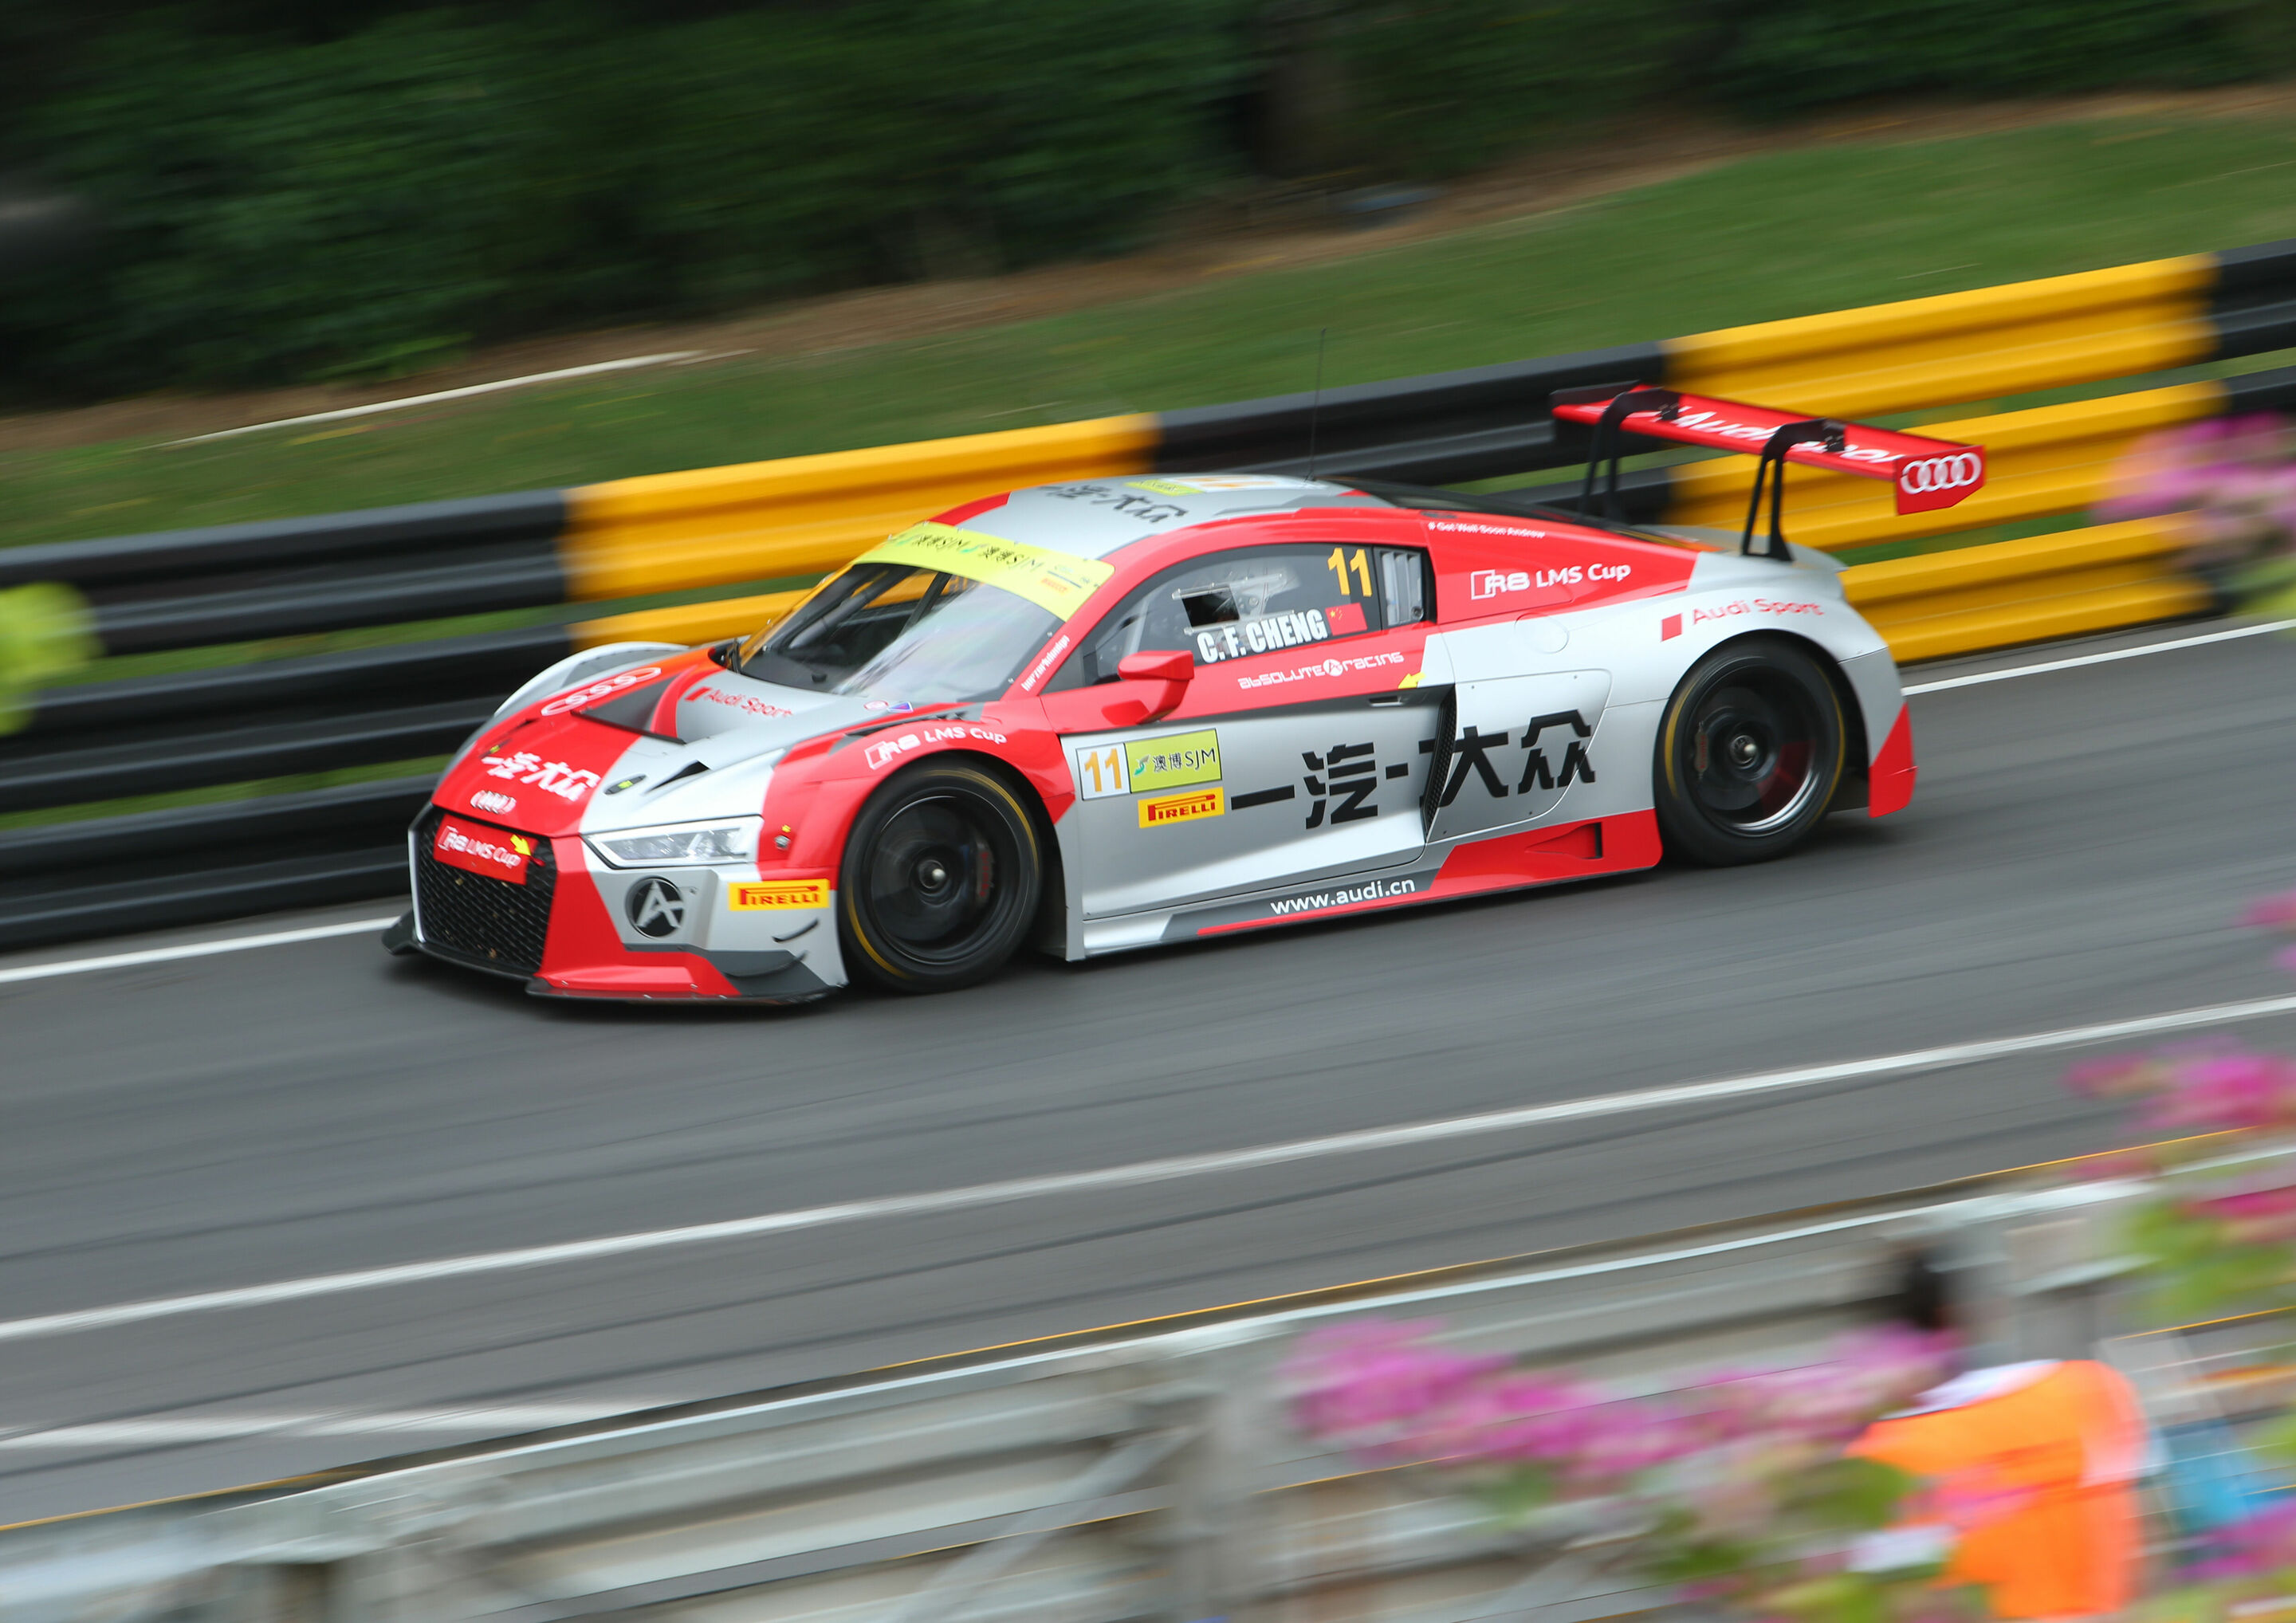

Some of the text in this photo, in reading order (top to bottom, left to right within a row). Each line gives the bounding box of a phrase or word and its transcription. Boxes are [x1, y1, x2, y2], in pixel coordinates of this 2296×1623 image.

[1327, 548, 1372, 597] 11
[1478, 564, 1631, 597] R8 LMS Cup
[1693, 598, 1825, 625] Audi Sport
[1197, 608, 1328, 664] C. F. CHENG
[741, 697, 792, 717] Sport
[924, 726, 967, 743] LMS
[969, 727, 1008, 745] Cup
[1084, 748, 1122, 792] 11
[1147, 793, 1216, 822] PIRELLI
[466, 838, 496, 859] LMS
[493, 847, 521, 869] Cup
[738, 886, 820, 906] PIRELLI
[1270, 877, 1415, 915] www.audi.cn
